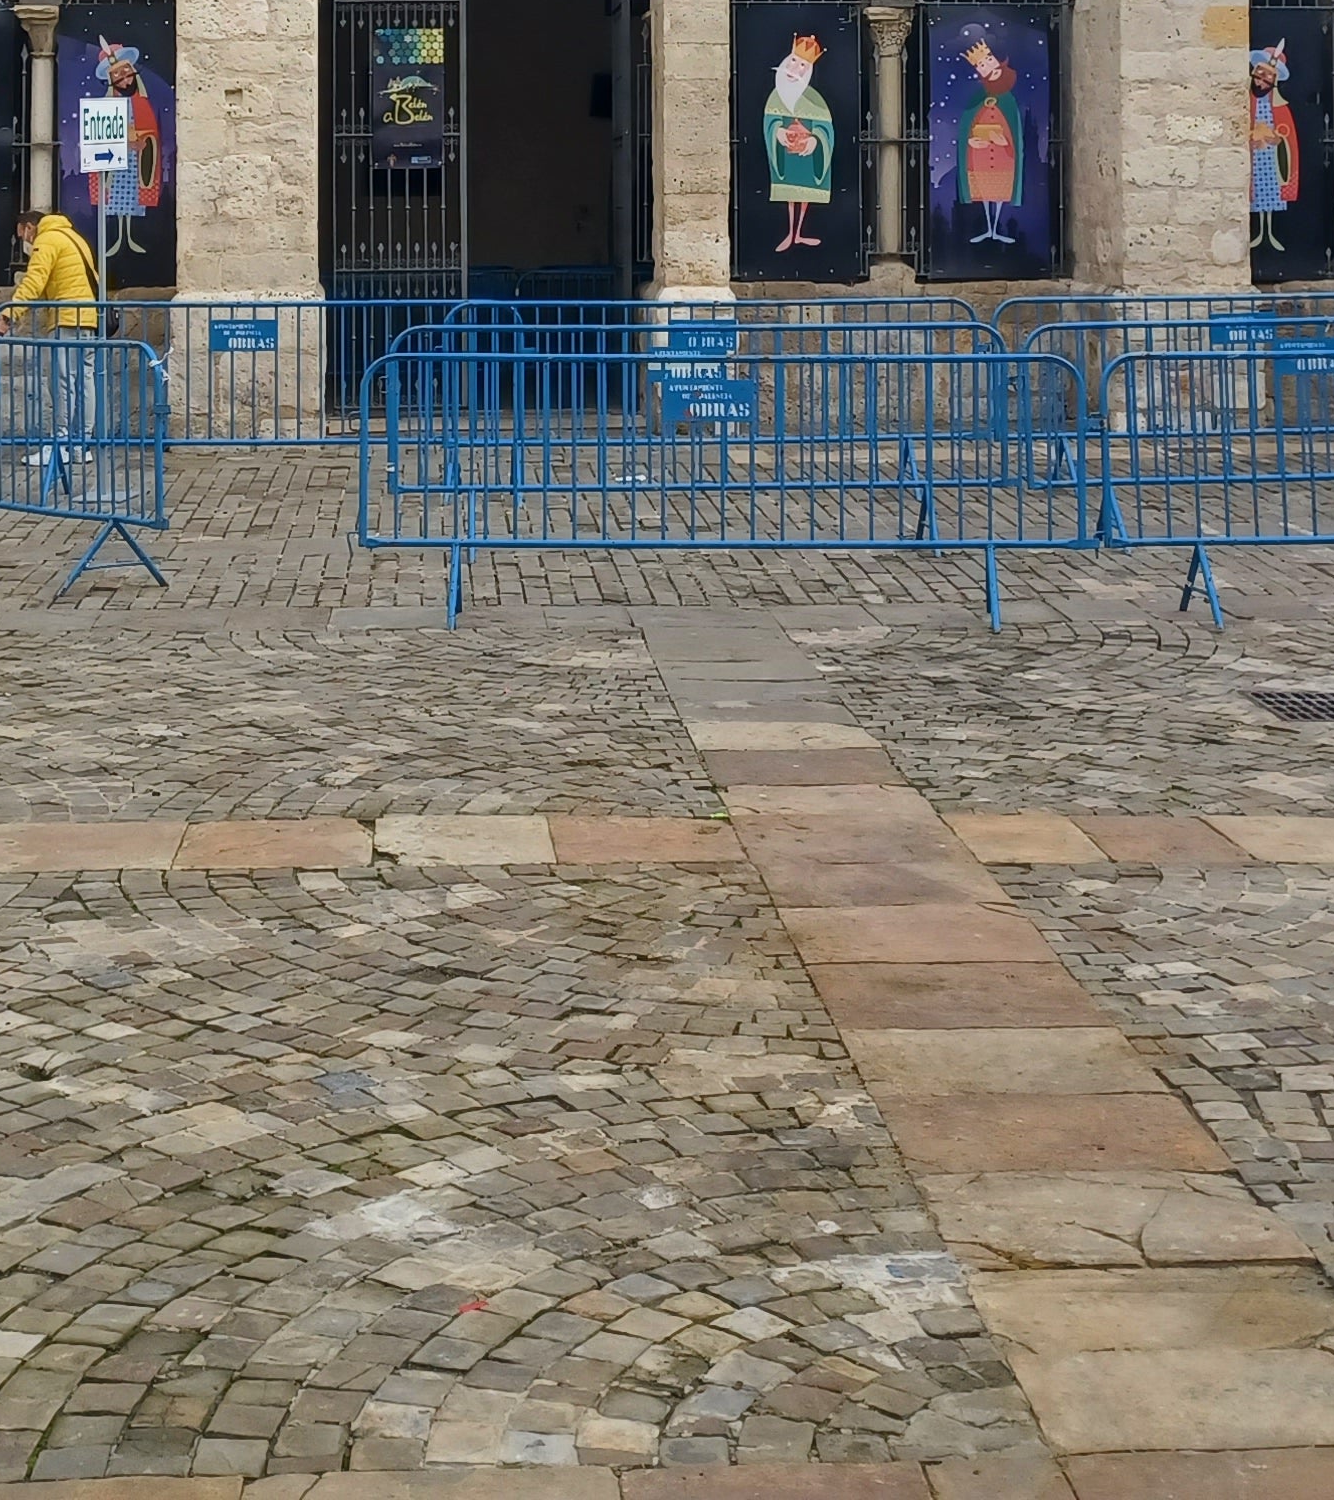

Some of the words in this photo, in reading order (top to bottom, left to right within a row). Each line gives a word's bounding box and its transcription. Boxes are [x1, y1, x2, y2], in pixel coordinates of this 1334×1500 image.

[83, 106, 124, 140] Entrada
[228, 337, 275, 349] OBRAS
[688, 402, 751, 417] OBRAS
